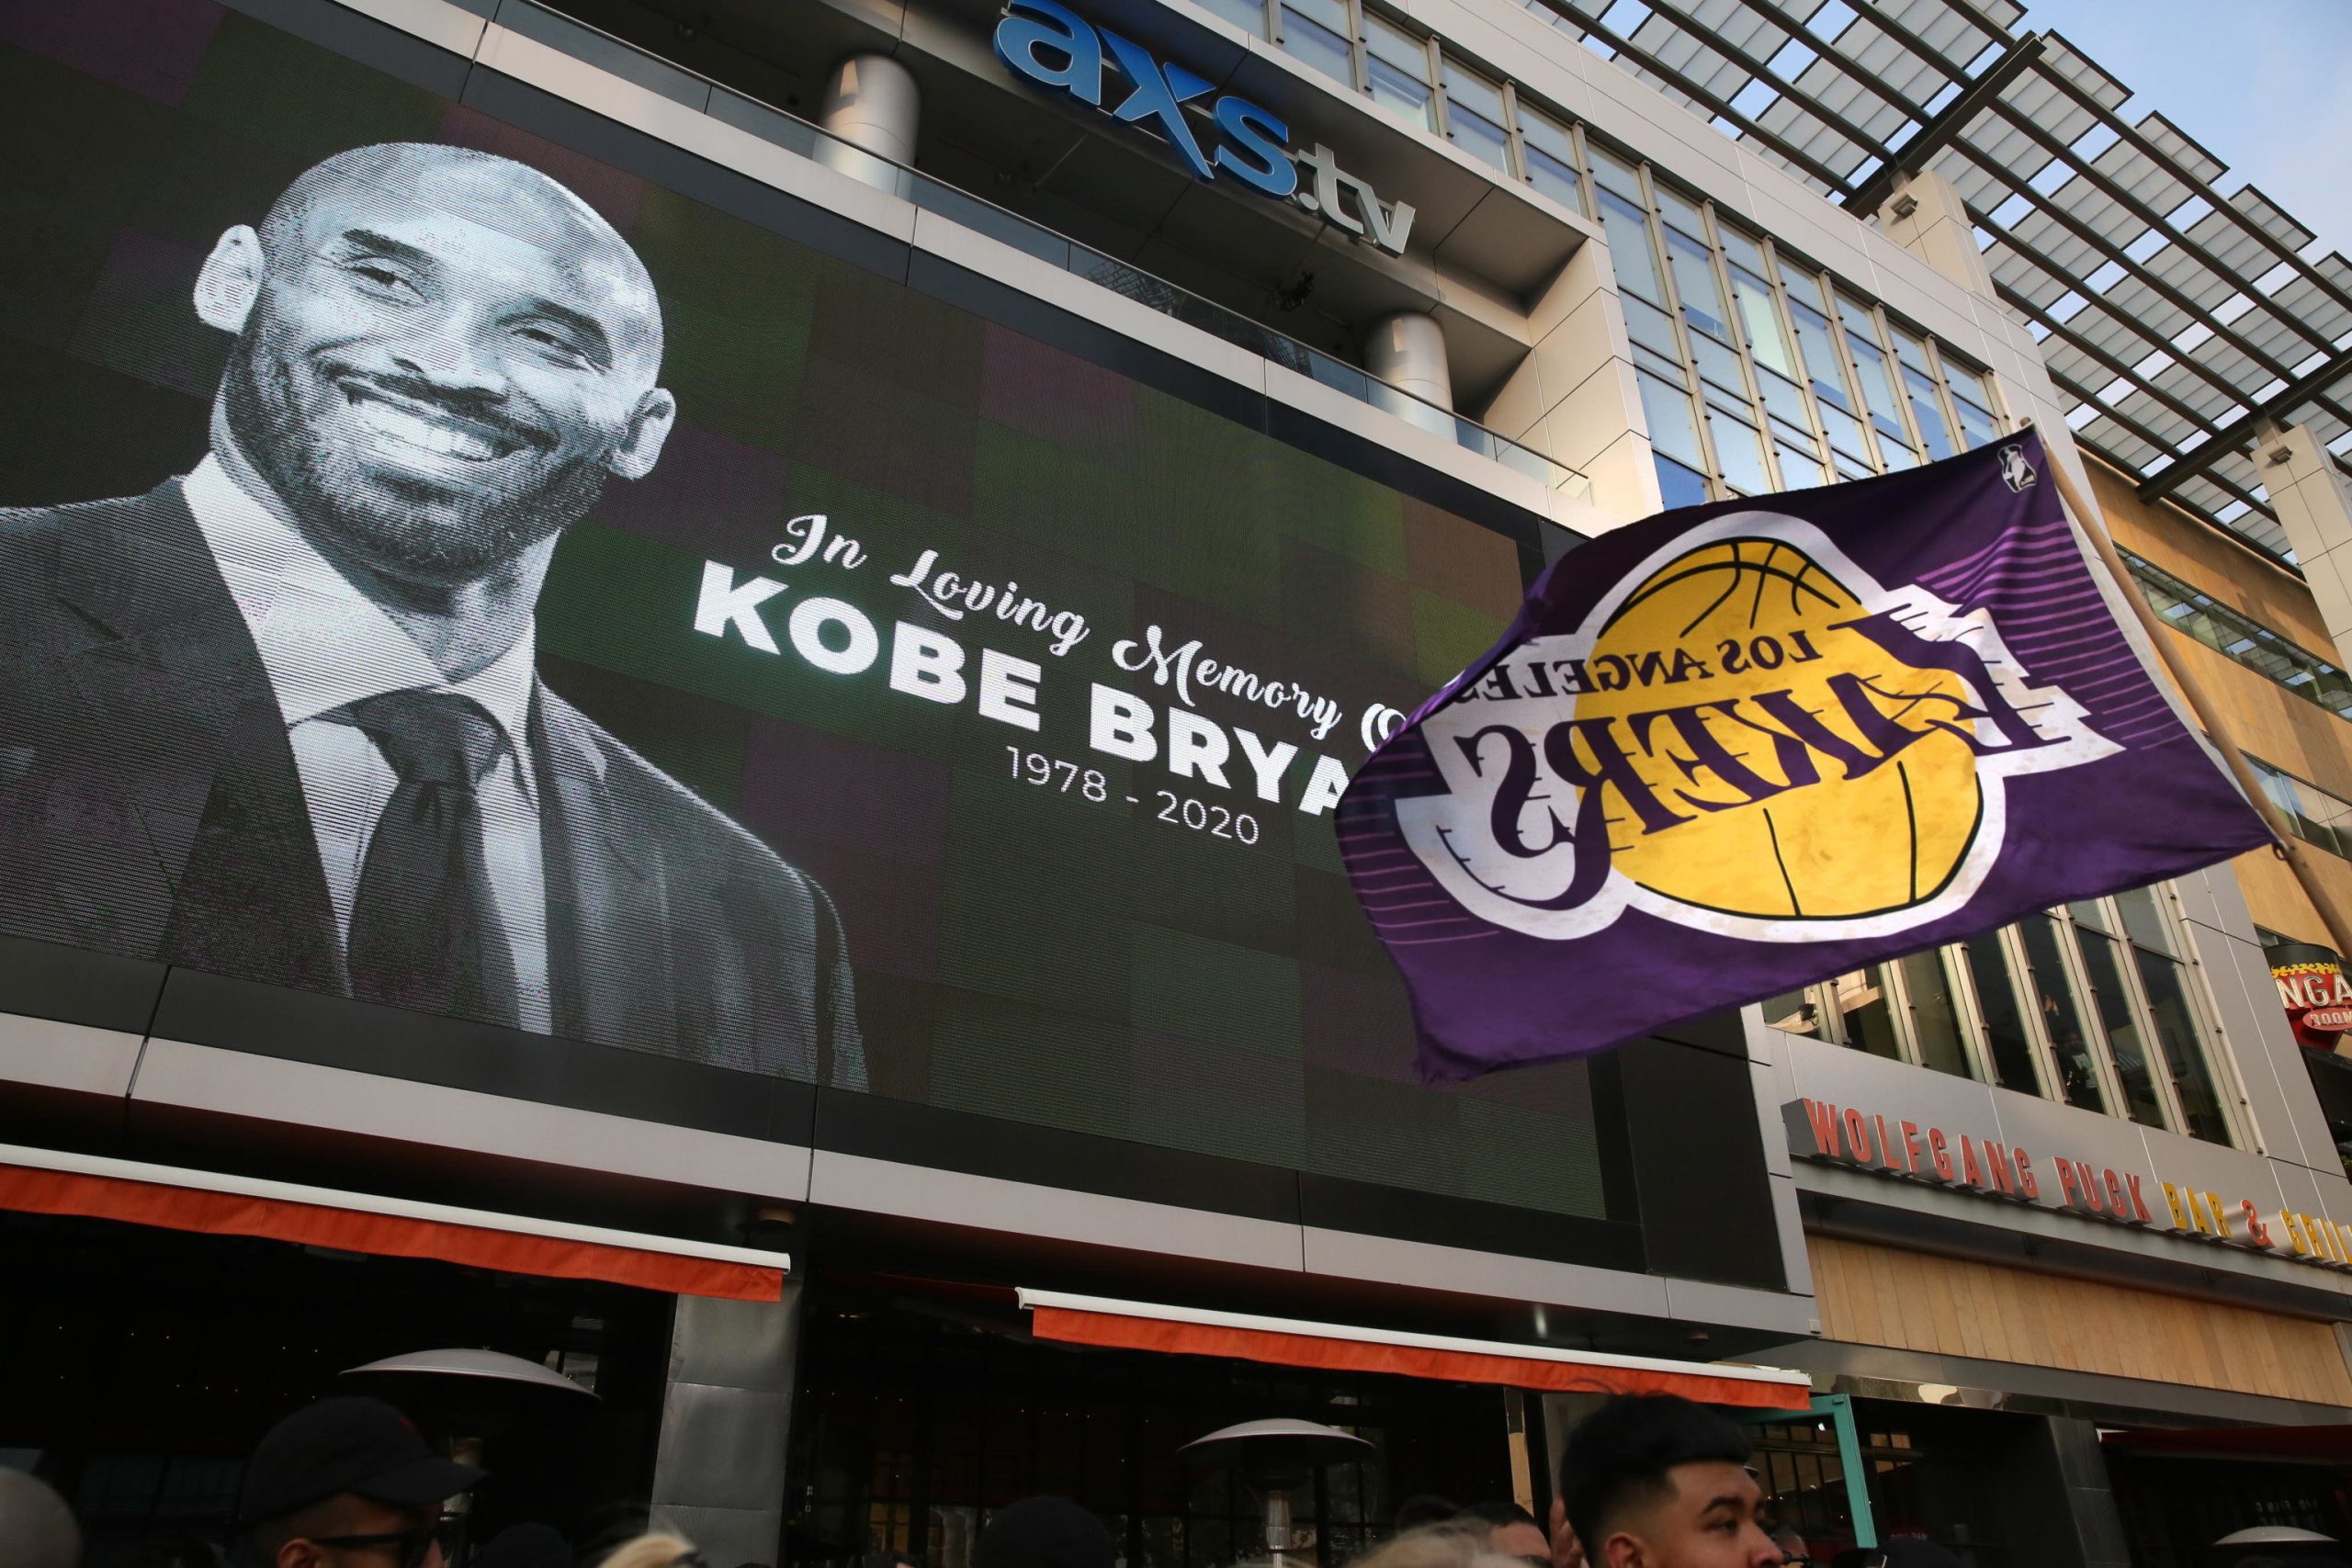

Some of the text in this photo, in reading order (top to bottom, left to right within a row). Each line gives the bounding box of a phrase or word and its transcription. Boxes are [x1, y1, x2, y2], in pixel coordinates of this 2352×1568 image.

[694, 559, 1350, 816] KOBE BRYA
[772, 514, 866, 570] In
[890, 549, 1091, 657] Loving
[1111, 625, 1342, 740] Memory
[1005, 746, 1108, 803] 1978
[1156, 790, 1261, 845] 2020
[2275, 974, 2352, 1008] NGA
[1802, 1098, 2040, 1199] WOLFGANG
[2052, 1156, 2153, 1224] PUCK
[2161, 1181, 2234, 1239] BAR
[2240, 1198, 2276, 1248] &
